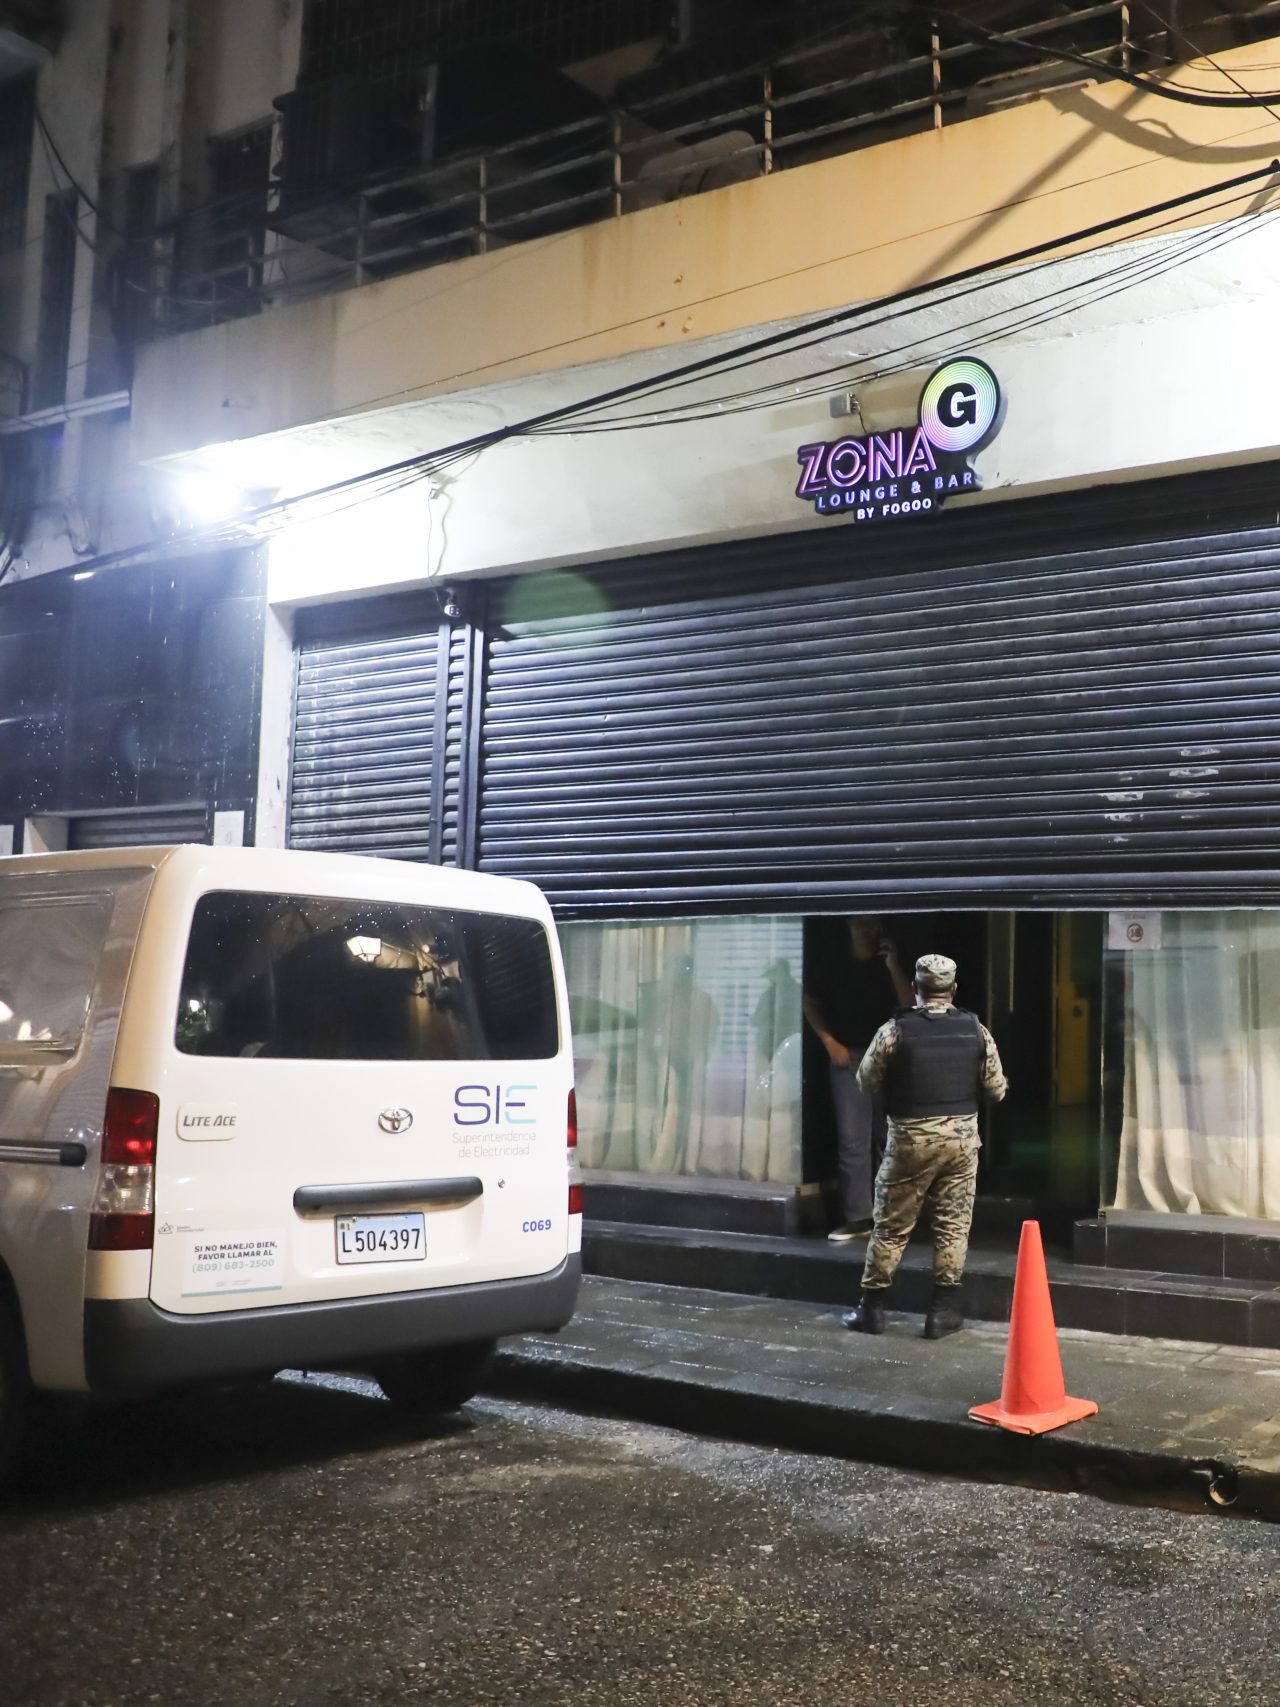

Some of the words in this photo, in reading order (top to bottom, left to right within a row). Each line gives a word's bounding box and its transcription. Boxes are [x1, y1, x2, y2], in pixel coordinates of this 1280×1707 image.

[798, 426, 937, 493] ZONA
[936, 382, 978, 428] G
[818, 484, 898, 509] LOUNGE
[911, 481, 921, 494] &
[934, 472, 973, 490] BAR
[857, 507, 874, 520] BY
[882, 498, 932, 516] FOGOO
[454, 1085, 537, 1125] SIE
[452, 1131, 536, 1144] Superintendencia
[458, 1147, 471, 1158] de
[474, 1144, 530, 1157] Electricidad
[205, 1244, 217, 1252] NO
[220, 1242, 254, 1251] MANEJO
[257, 1241, 278, 1249] BIEN,
[342, 1228, 421, 1253] L504397
[198, 1252, 225, 1260] FAVOR
[228, 1250, 261, 1259] LLAMAR
